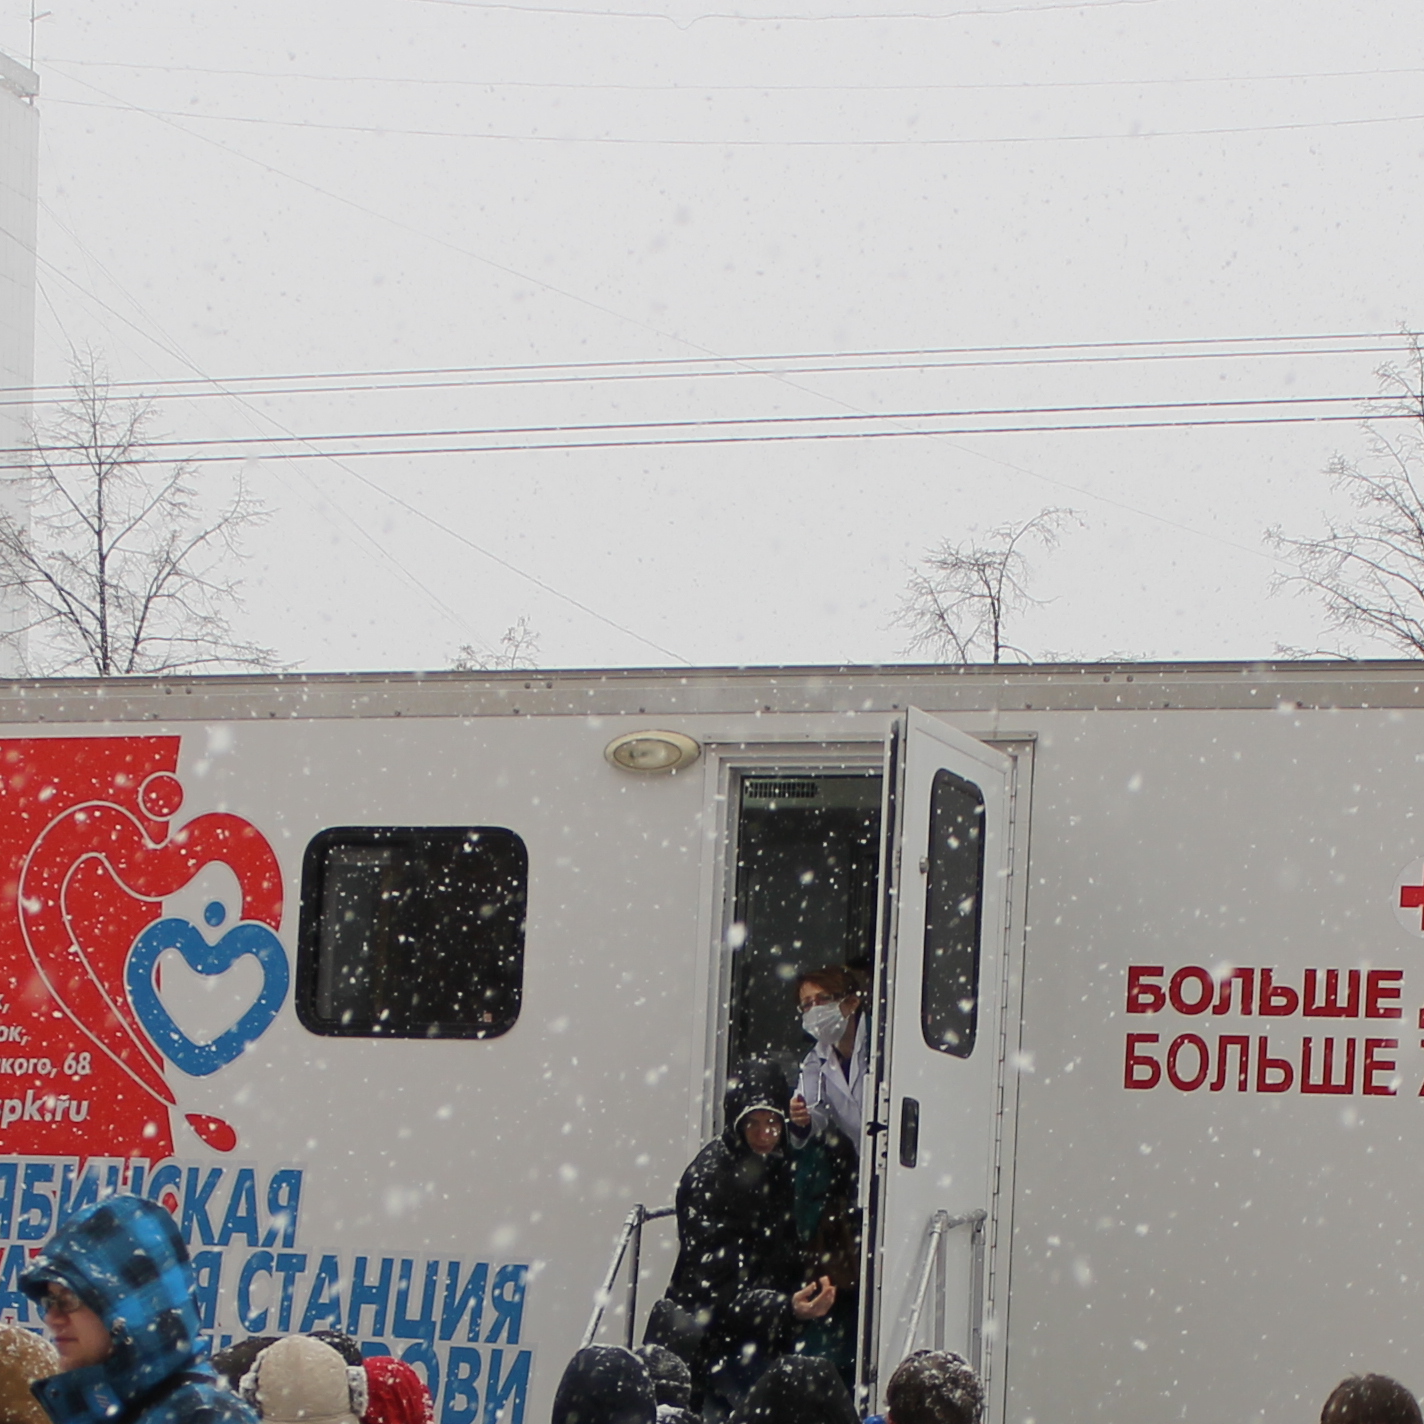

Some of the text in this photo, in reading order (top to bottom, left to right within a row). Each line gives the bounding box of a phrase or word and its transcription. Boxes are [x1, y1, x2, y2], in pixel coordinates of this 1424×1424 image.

[1125, 965, 1404, 1019] БОЛЬШЕ
[63, 1051, 92, 1076] 68
[1123, 1032, 1399, 1097] БОЛЬШЕ
[237, 1250, 530, 1345] СТАНЦИЯ
